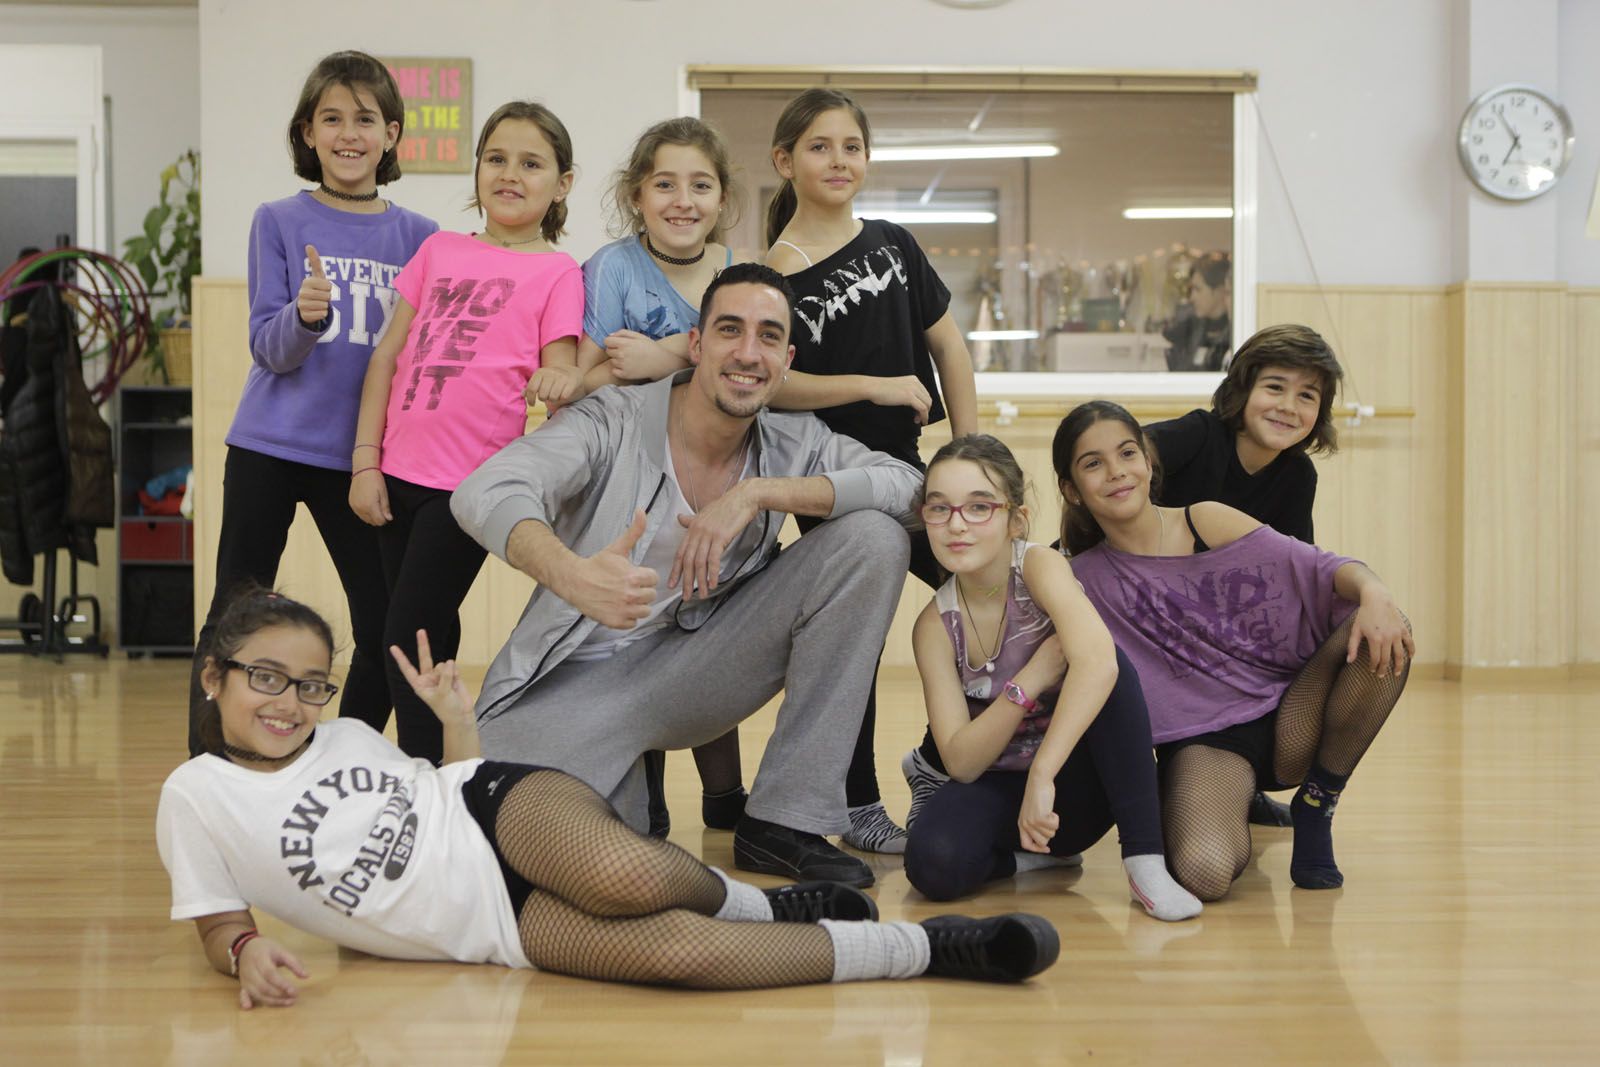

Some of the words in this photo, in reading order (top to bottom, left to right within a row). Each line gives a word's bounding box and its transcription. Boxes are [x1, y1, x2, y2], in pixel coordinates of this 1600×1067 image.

[388, 66, 432, 98] ME
[439, 66, 460, 98] IS
[421, 105, 460, 129] THE
[437, 138, 457, 161] IS
[303, 255, 404, 289] SEVENT
[420, 277, 516, 319] MO
[411, 319, 491, 365] VE
[401, 365, 466, 411] IT
[281, 789, 330, 891] NEW
[316, 766, 405, 800] YOR
[322, 823, 396, 917] LOCALS
